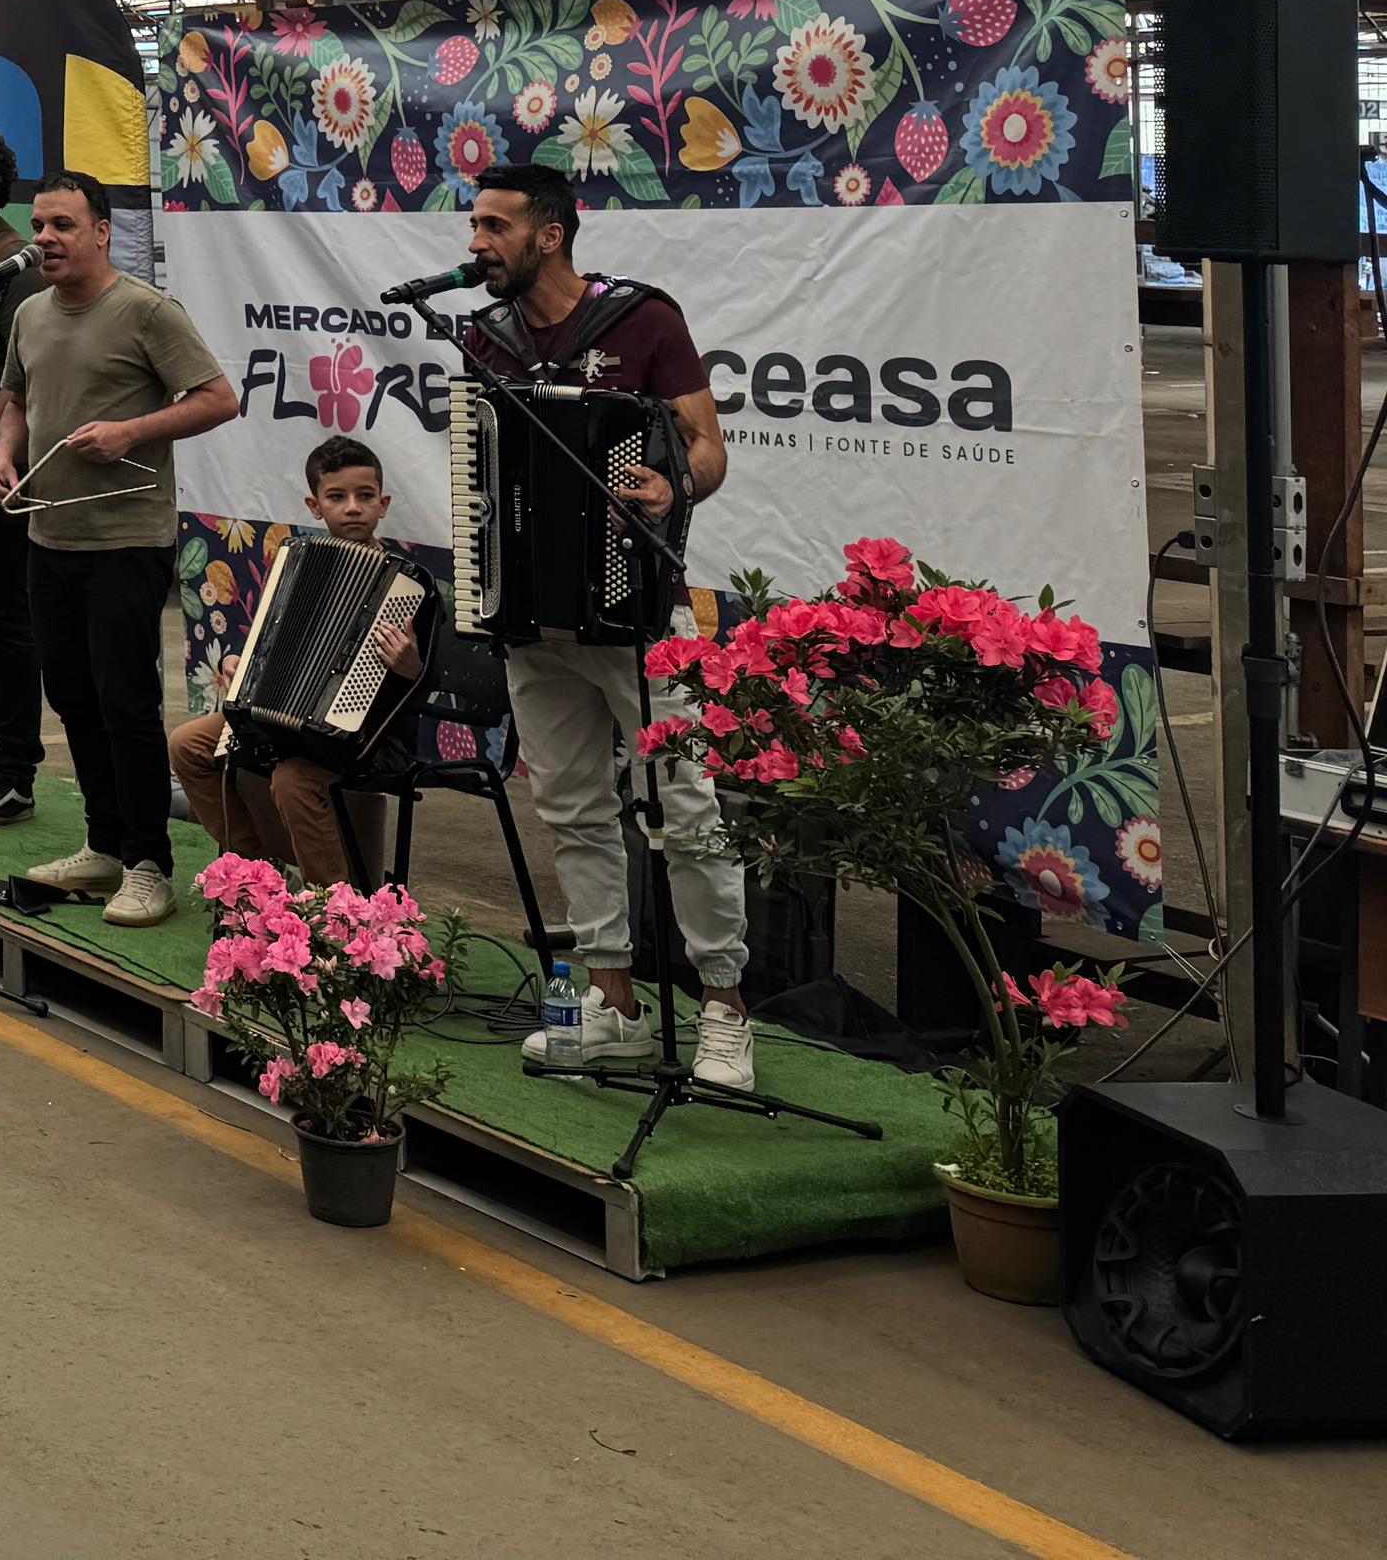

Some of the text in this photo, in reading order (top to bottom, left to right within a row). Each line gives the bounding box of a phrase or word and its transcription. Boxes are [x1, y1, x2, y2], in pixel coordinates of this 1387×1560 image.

[244, 303, 413, 339] MERCADO
[700, 348, 1014, 433] ceasa
[722, 428, 1016, 465] MPINAS FONTE DE SAÚDE
